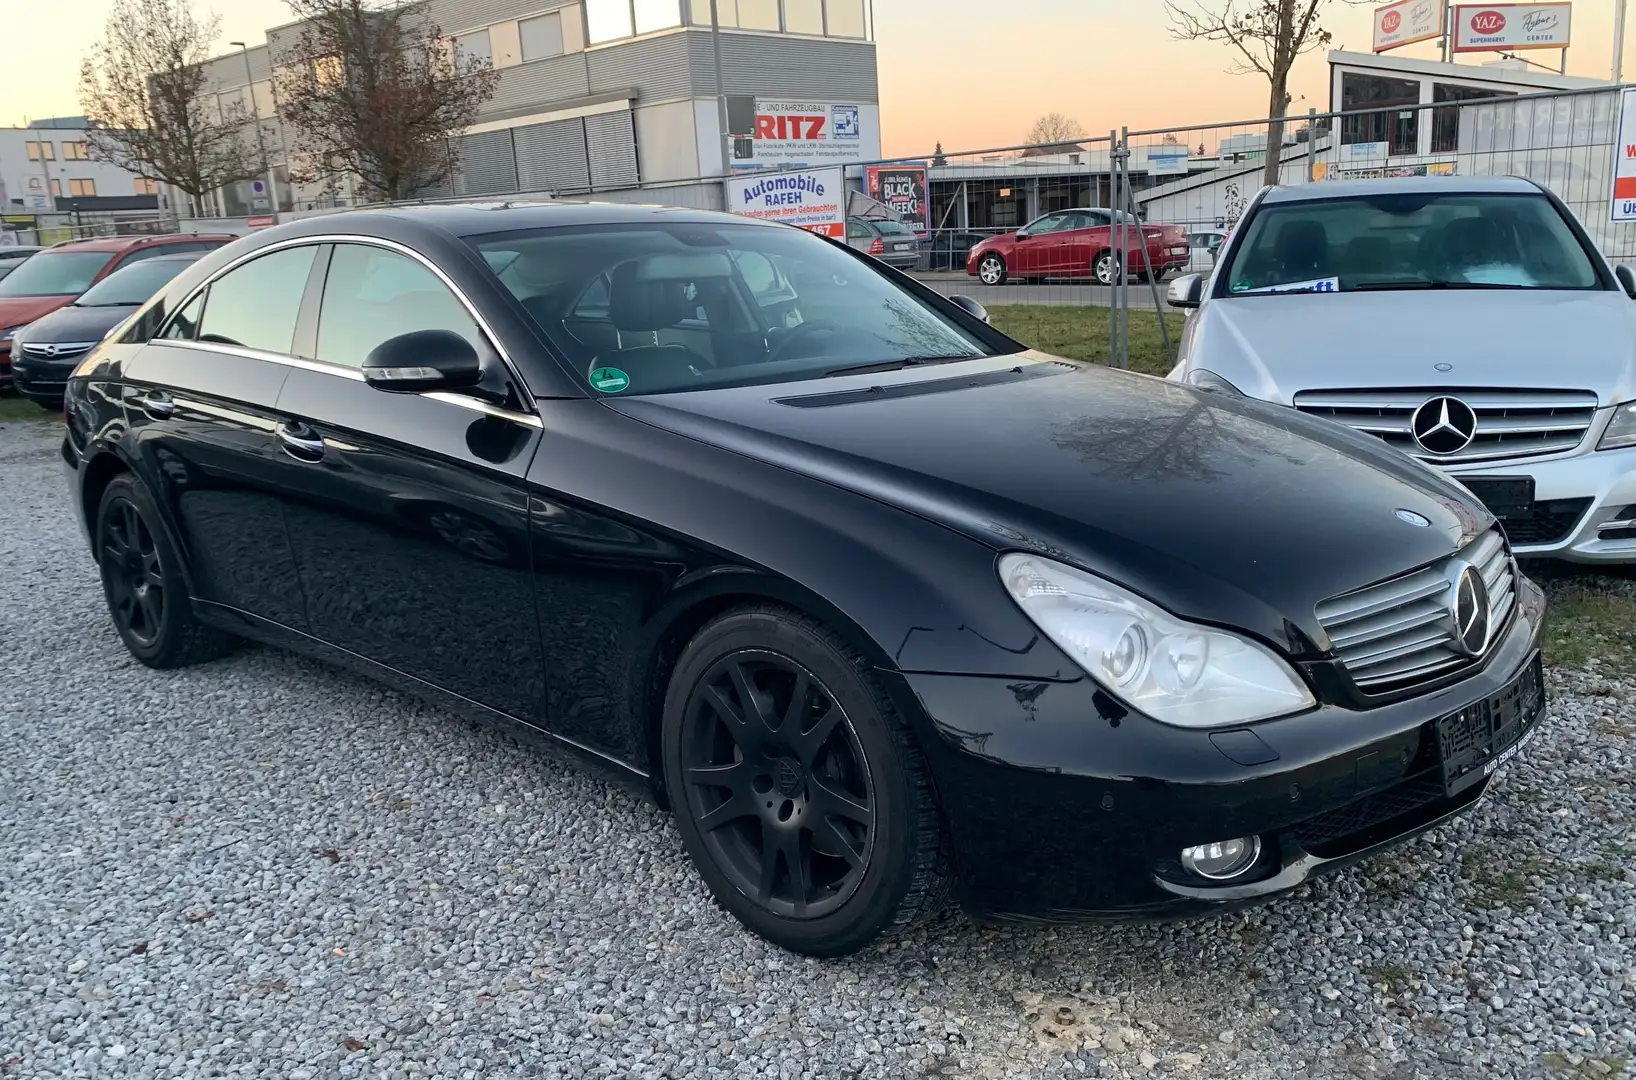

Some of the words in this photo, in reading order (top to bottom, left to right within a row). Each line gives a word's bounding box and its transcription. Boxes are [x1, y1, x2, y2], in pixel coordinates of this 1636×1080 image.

[1474, 16, 1497, 29] YAZ
[1470, 36, 1505, 44] SUPERMARKT
[781, 104, 825, 112] FAHRZEUGBAU
[753, 115, 826, 140] RITZ
[743, 175, 825, 204] Automobile
[884, 177, 917, 199] BLACK
[765, 192, 802, 206] RAFEH
[781, 206, 797, 215] ihren
[798, 203, 838, 214] Gebrauchten
[885, 200, 917, 214] WEEK!
[603, 369, 613, 380] 4
[1483, 759, 1498, 776] AUTO
[1498, 745, 1517, 765] CENTER
